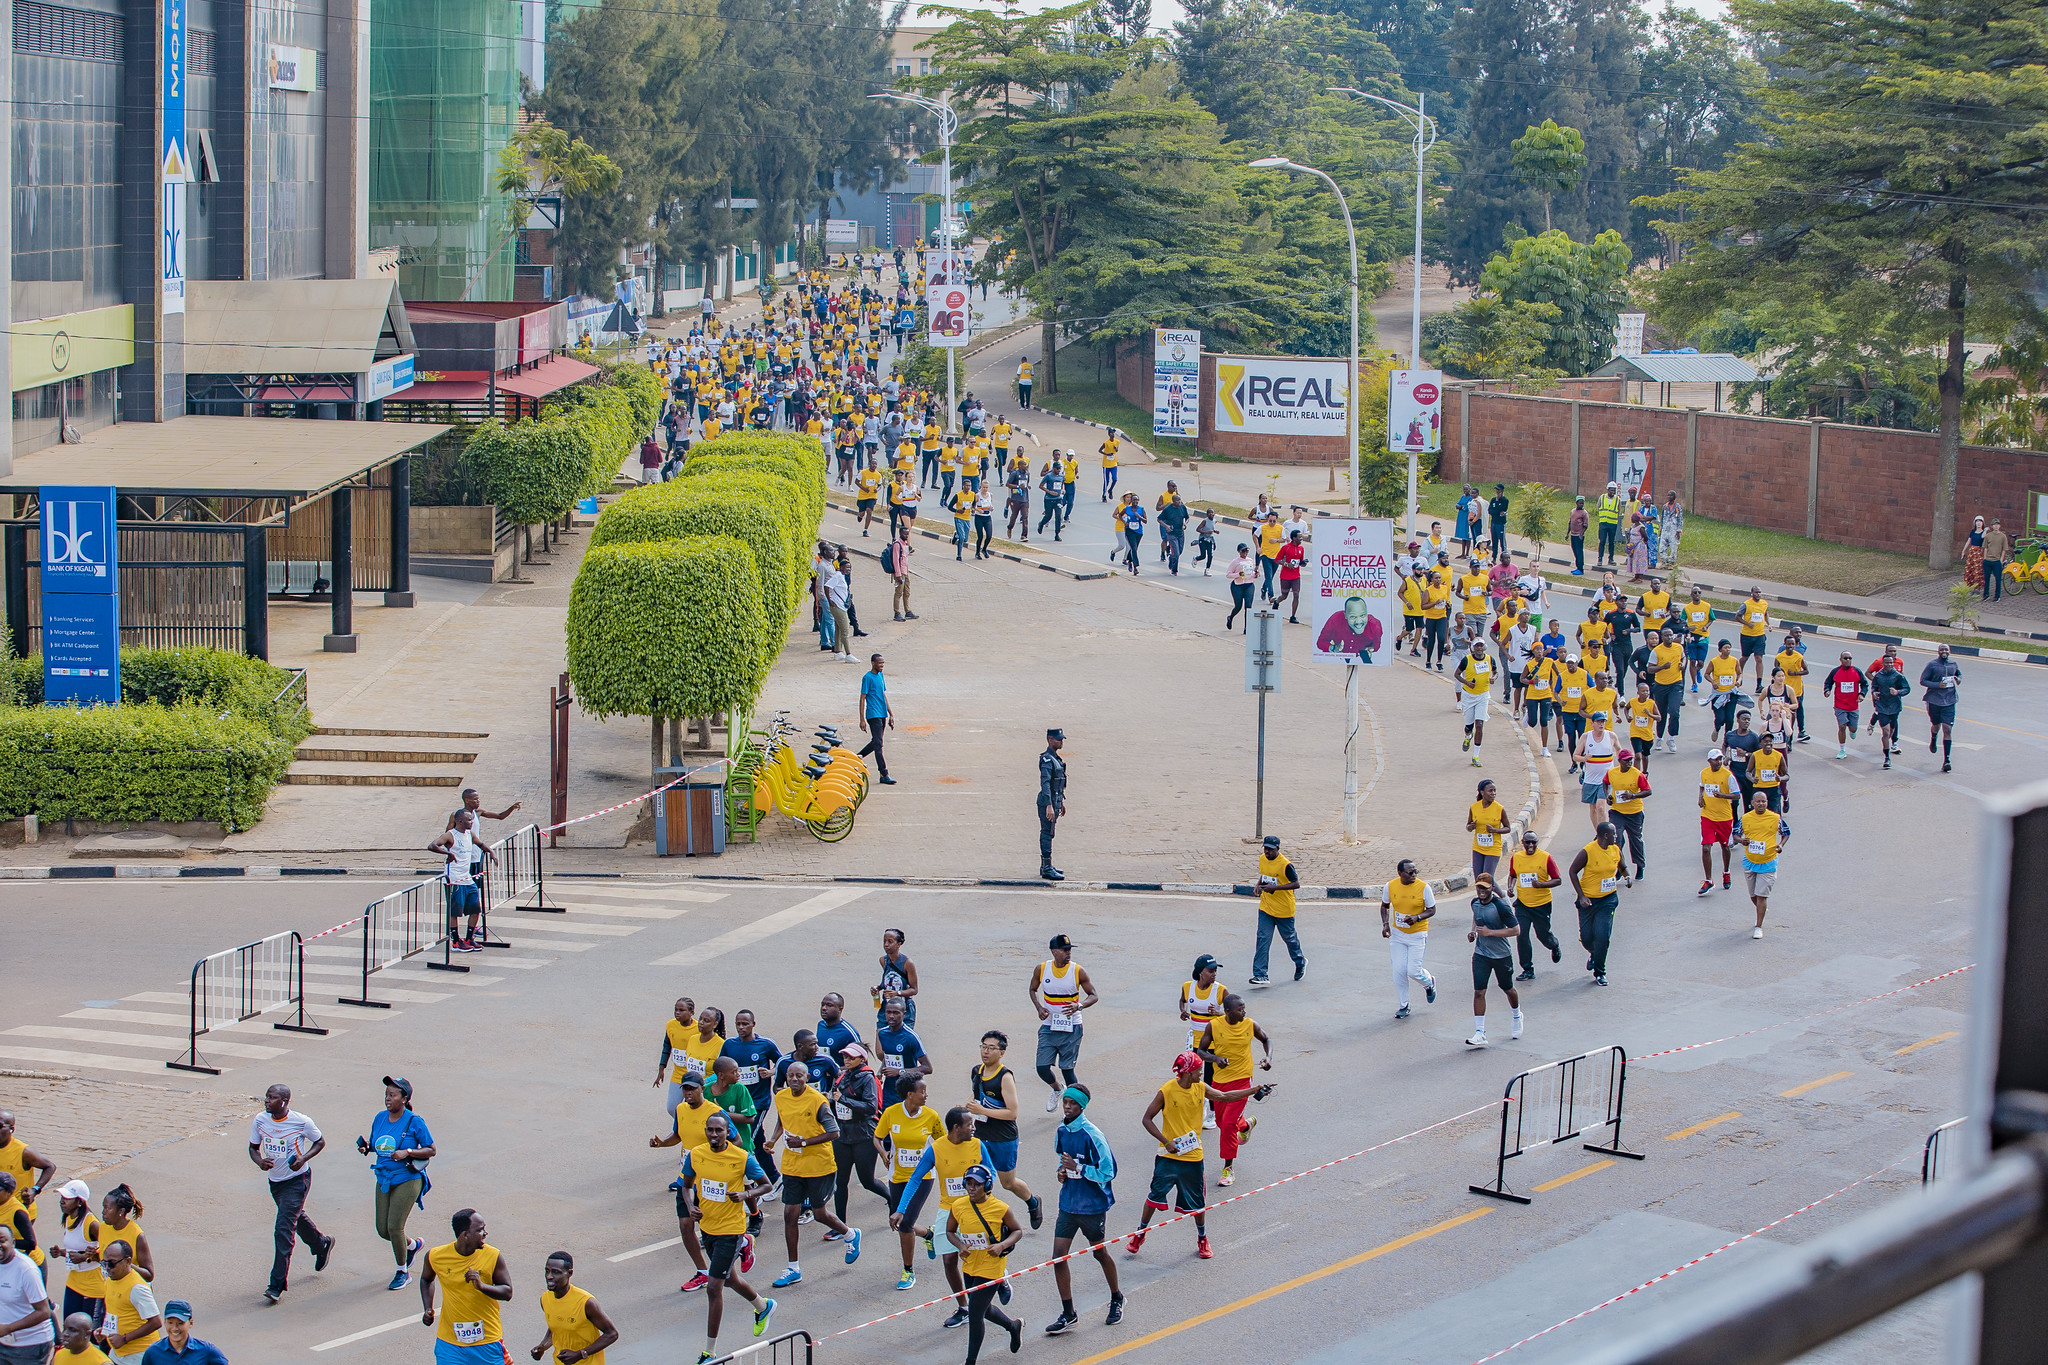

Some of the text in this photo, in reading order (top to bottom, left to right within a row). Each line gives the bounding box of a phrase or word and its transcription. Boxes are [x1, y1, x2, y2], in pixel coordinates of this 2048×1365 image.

[932, 311, 964, 335] 4G
[1167, 333, 1197, 342] REAL
[56, 344, 66, 359] MTN
[1249, 376, 1344, 408] REAL
[1249, 409, 1345, 420] REAL QUALITY, REAL VALUE
[46, 501, 98, 563] bk
[1321, 554, 1386, 567] OHEREZA
[1321, 567, 1386, 579] UNAKIRE
[1321, 580, 1386, 588] AMAFARANGA
[1333, 589, 1387, 598] MURONGO
[740, 1072, 756, 1080] 3320
[265, 1144, 286, 1152] 13510
[702, 1186, 725, 1195] 10833
[948, 1183, 965, 1191] 108
[456, 1327, 482, 1337] 13048
